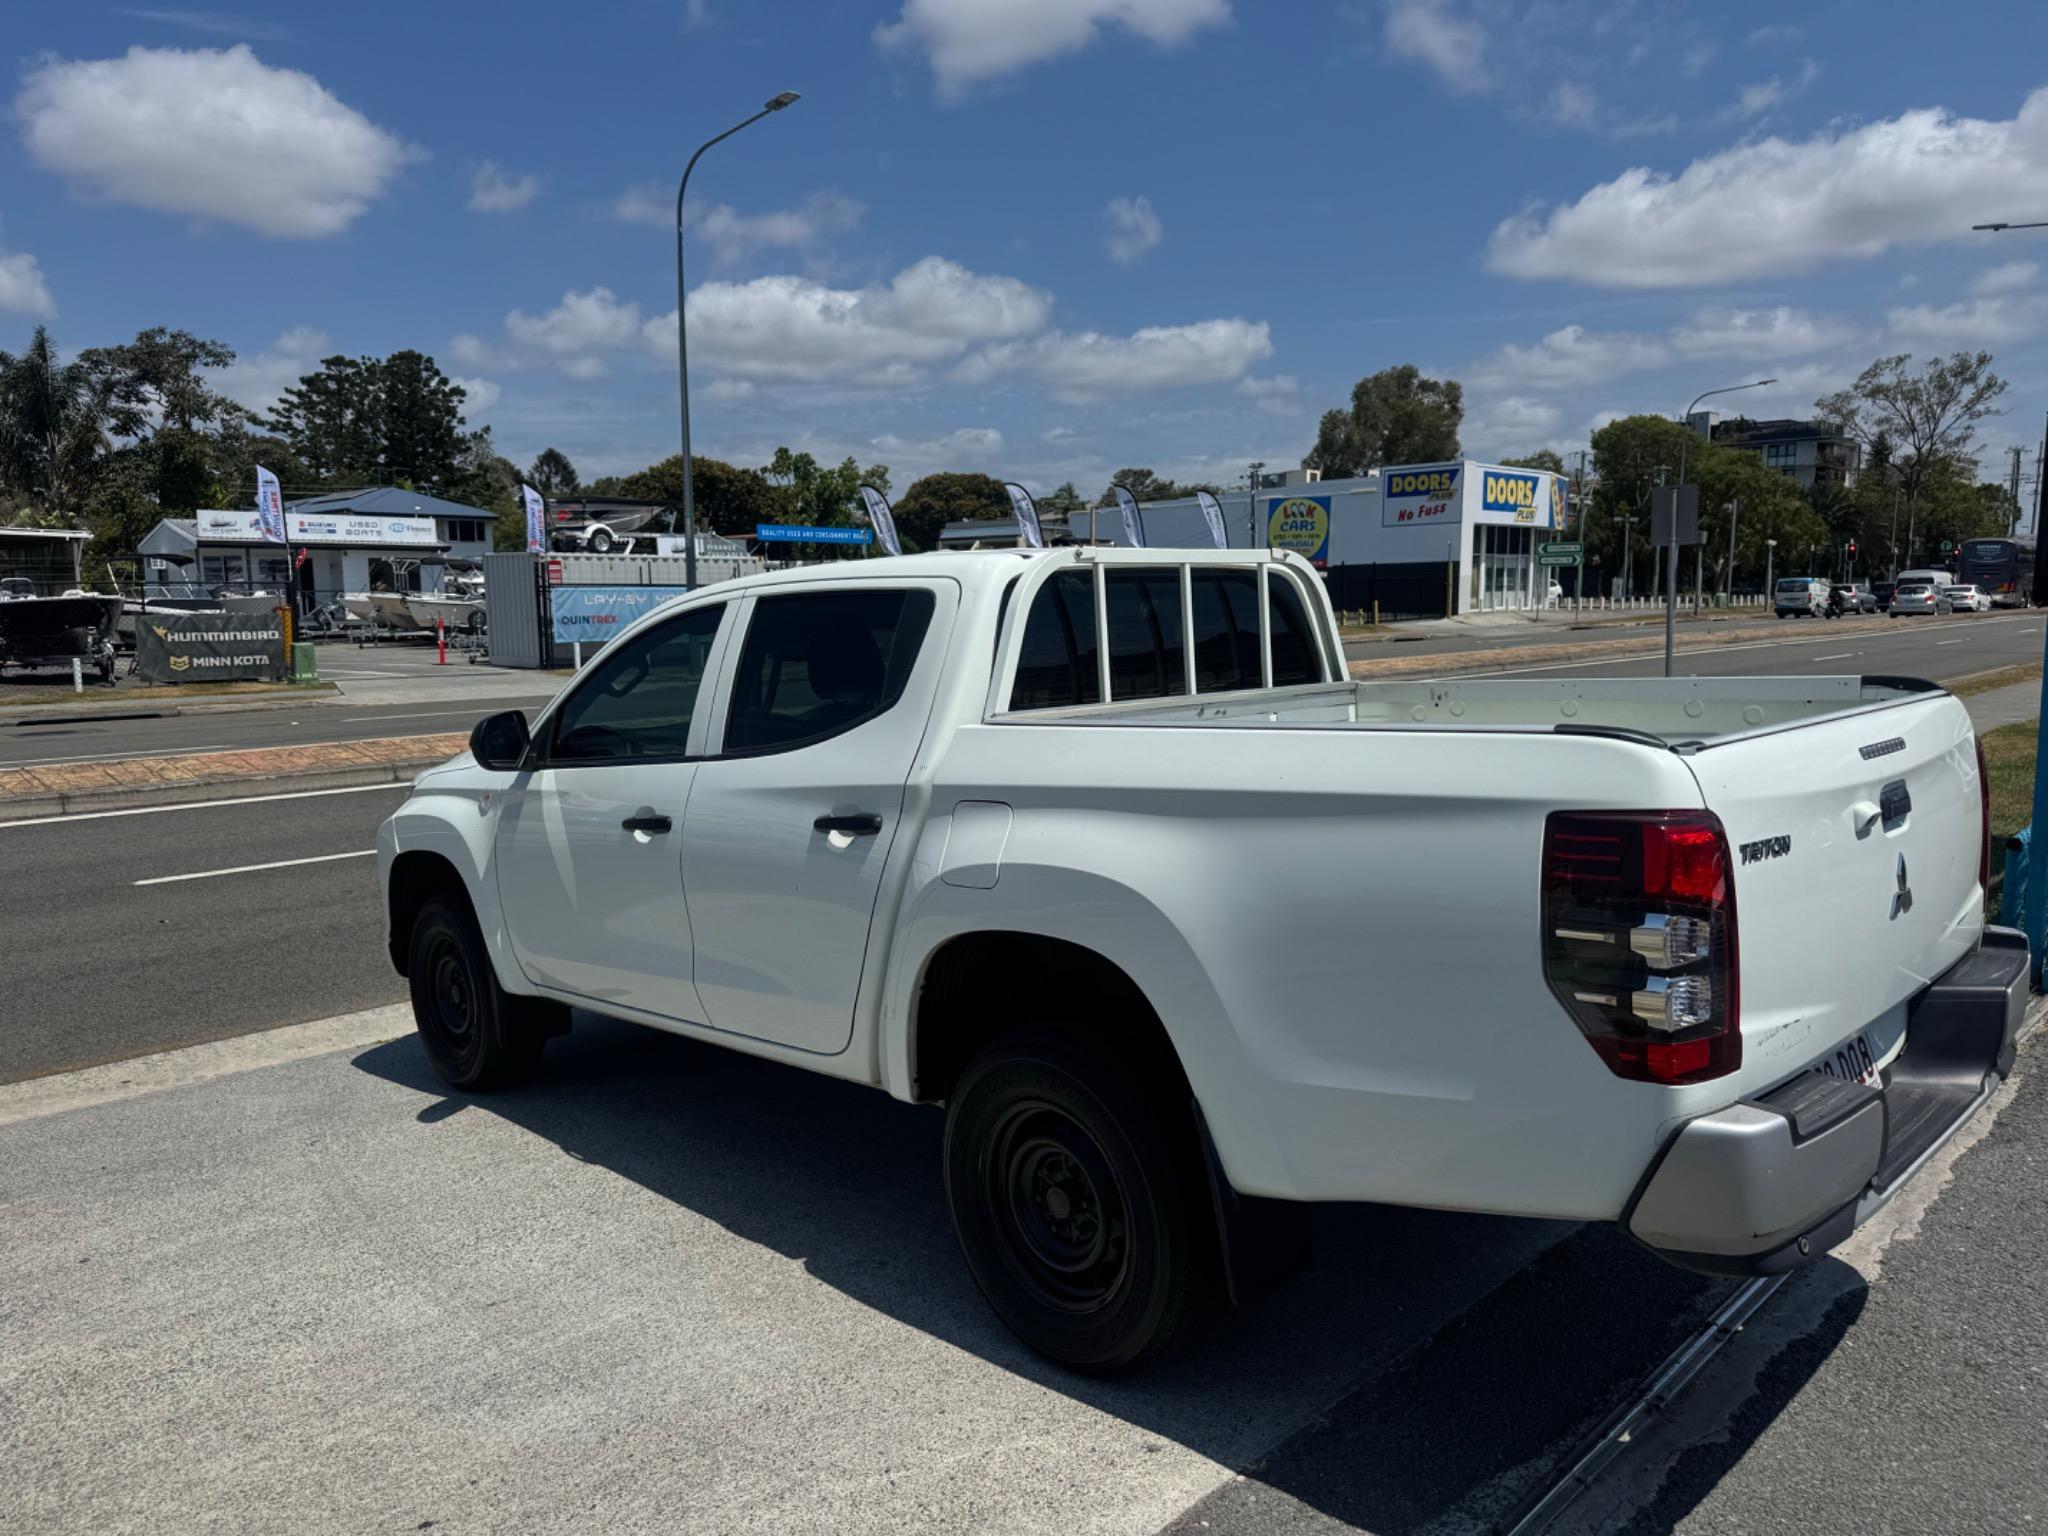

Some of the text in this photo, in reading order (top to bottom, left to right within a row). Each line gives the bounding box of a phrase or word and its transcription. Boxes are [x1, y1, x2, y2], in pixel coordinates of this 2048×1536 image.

[1391, 473, 1451, 493] DOORS
[1486, 476, 1533, 506] DOORS
[1283, 502, 1316, 519] LOOK
[1398, 503, 1447, 522] No Fuss
[1516, 509, 1535, 520] PLUS
[349, 520, 378, 529] USED
[1280, 520, 1316, 532] CARS
[345, 528, 382, 537] BOATS
[584, 593, 647, 605] LAY-BY
[561, 614, 618, 625] QUINTREX
[167, 629, 280, 642] HUMMINBIRD
[193, 654, 270, 668] MINN KOTA
[1739, 834, 1791, 866] TRITON
